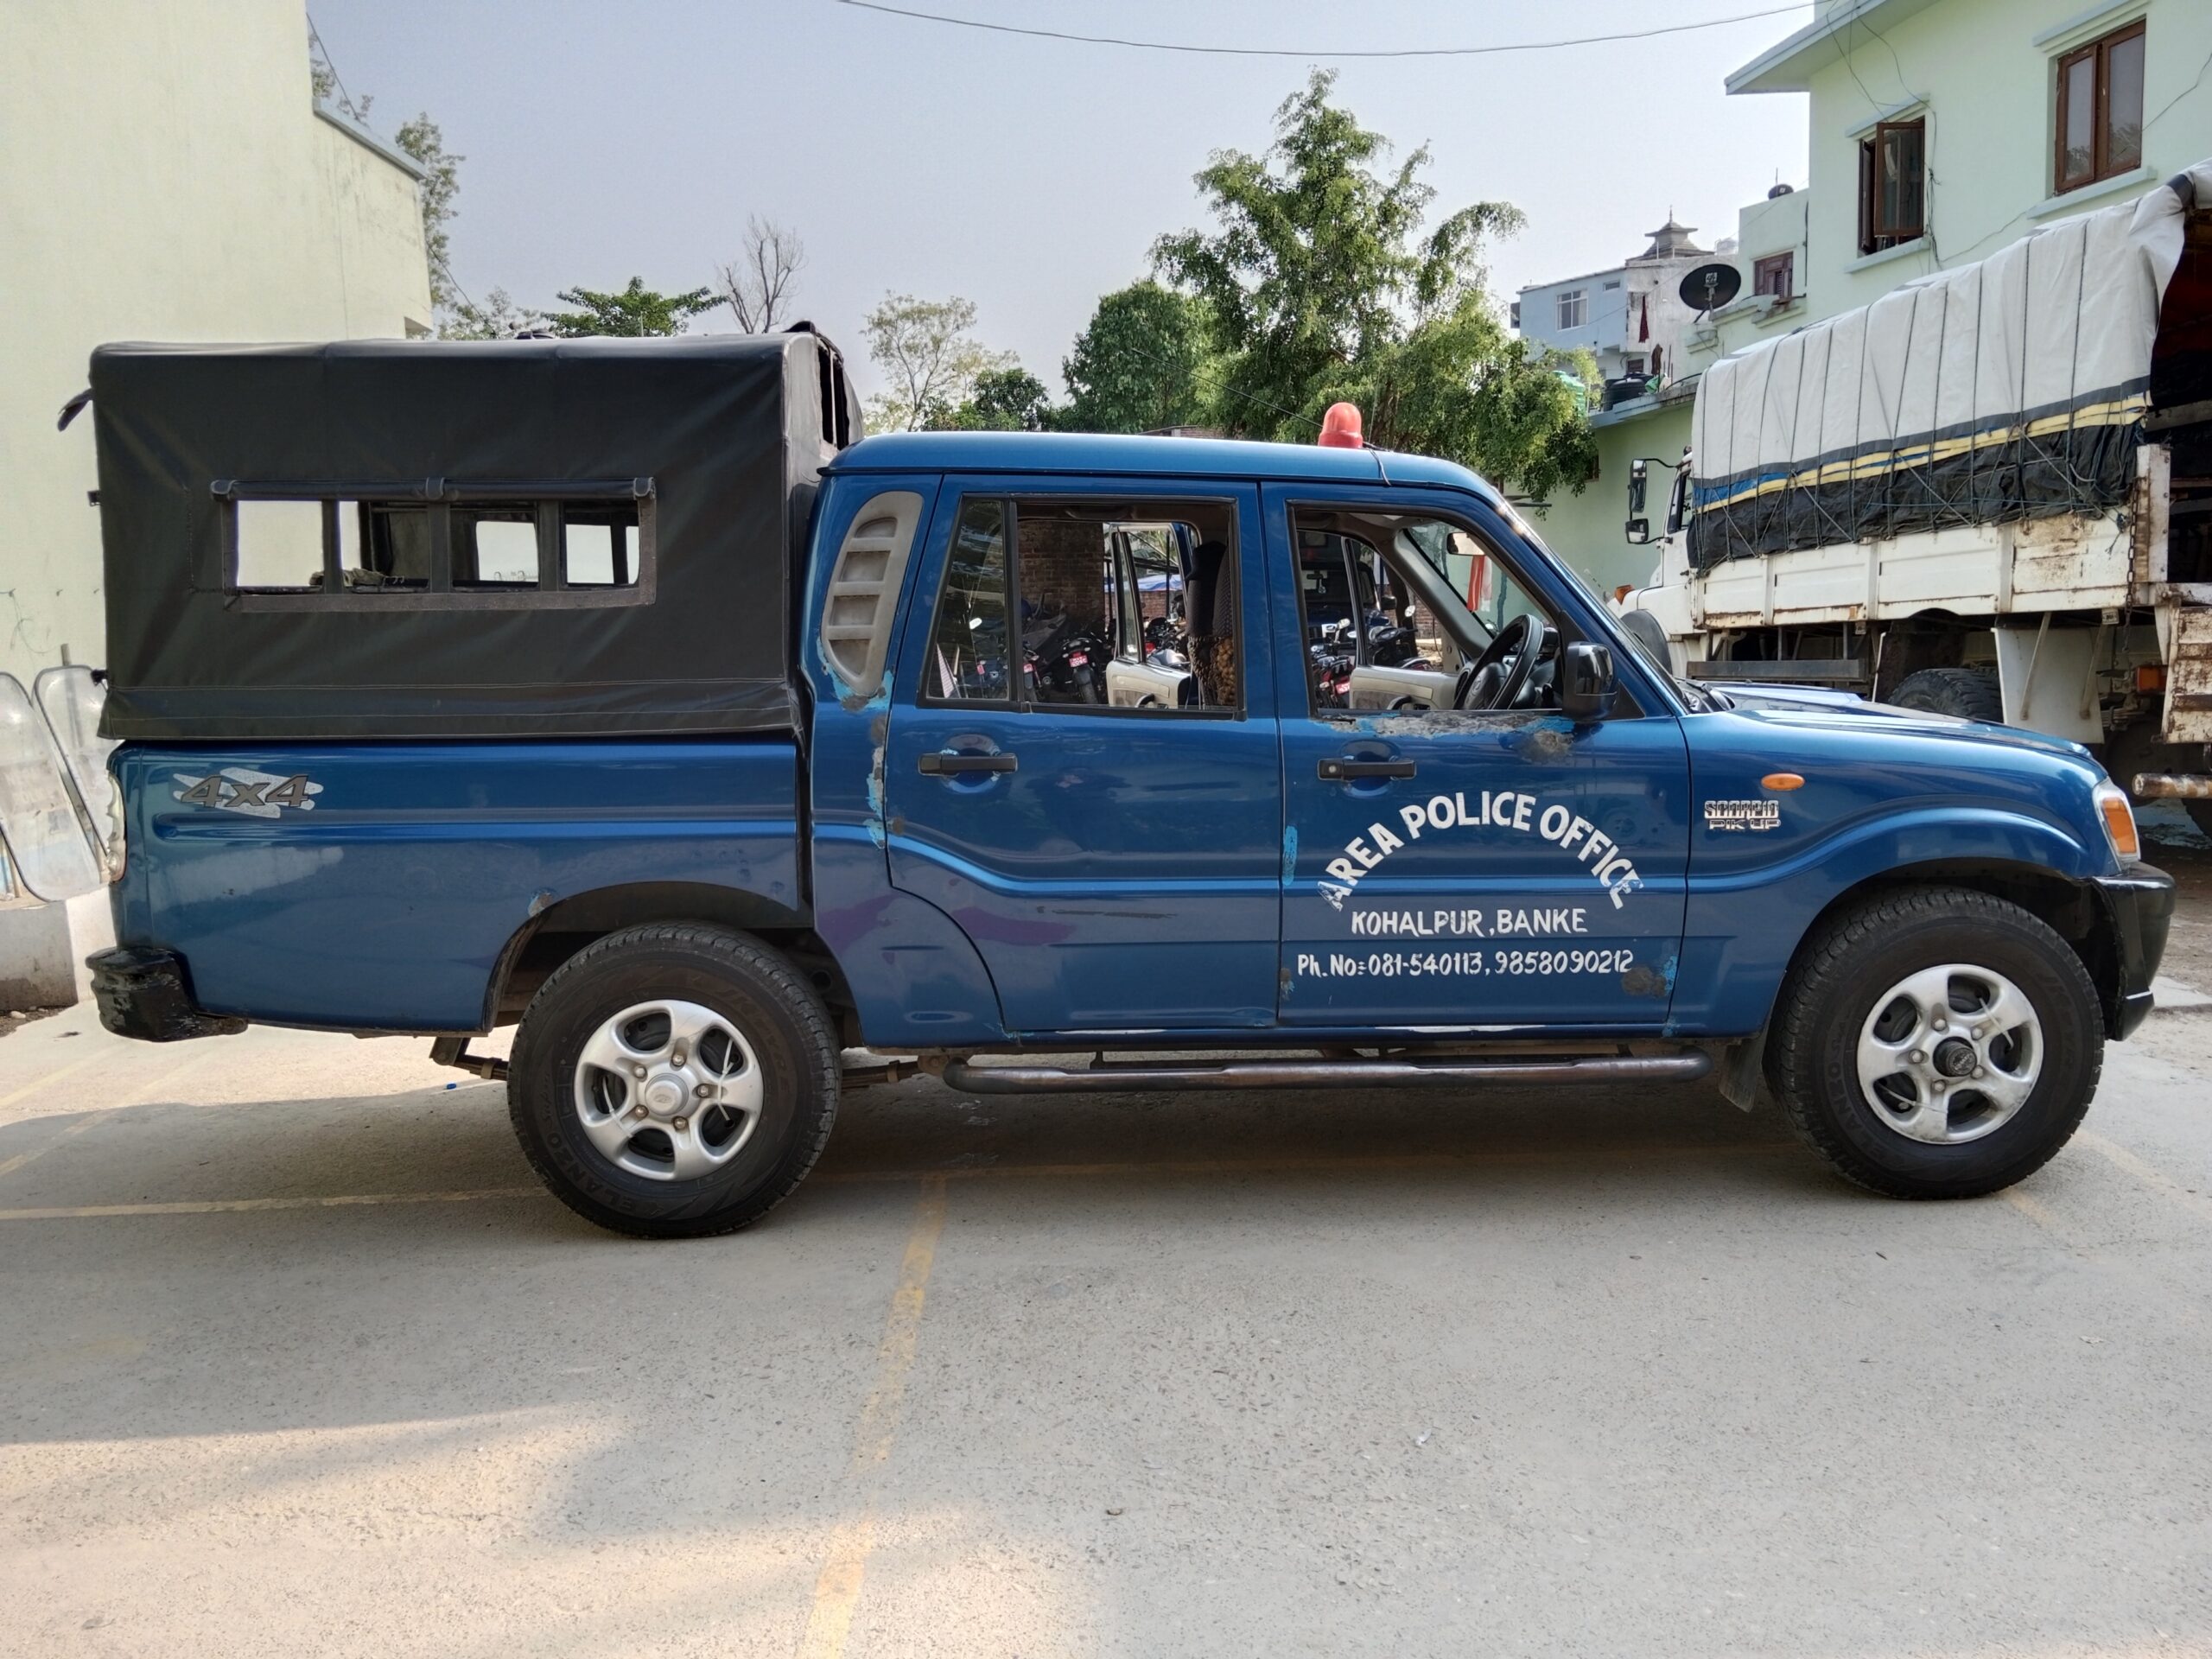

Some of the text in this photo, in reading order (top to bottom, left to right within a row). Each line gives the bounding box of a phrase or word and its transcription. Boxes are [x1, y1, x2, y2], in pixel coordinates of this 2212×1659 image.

[181, 774, 309, 808] 4x4
[1750, 818, 1782, 830] UP
[1316, 791, 1645, 912] AREA POLICE OFFICE
[1495, 950, 1634, 975] 9858090212
